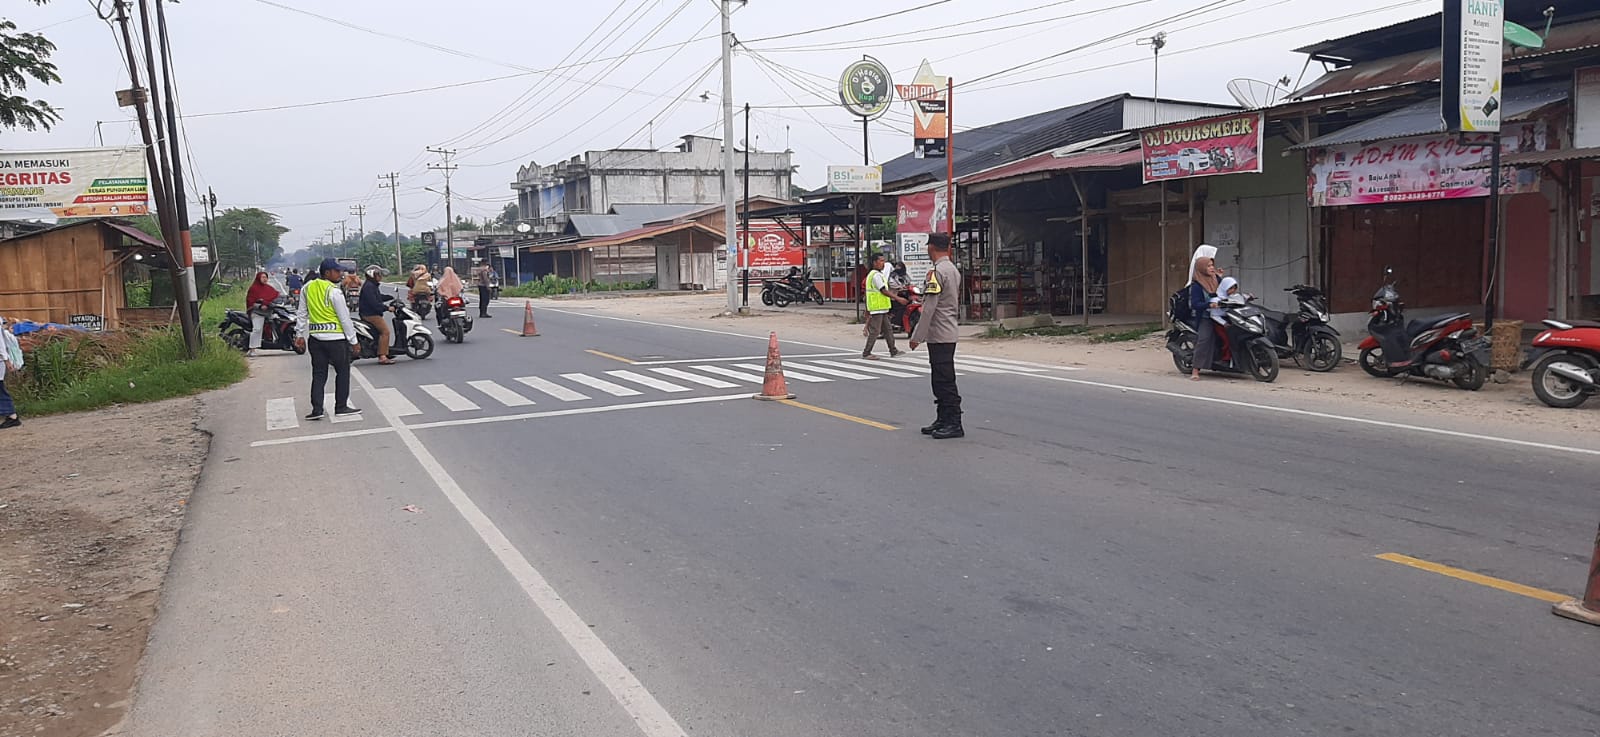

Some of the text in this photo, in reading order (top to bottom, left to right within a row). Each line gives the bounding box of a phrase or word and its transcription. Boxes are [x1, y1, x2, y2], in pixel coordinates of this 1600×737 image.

[1467, 0, 1498, 17] HANIF
[1163, 118, 1253, 145] DOORSMEER
[1349, 143, 1420, 167] ADAM
[14, 159, 70, 169] MEMASUKI
[833, 171, 850, 180] BSI
[904, 243, 919, 253] BSI
